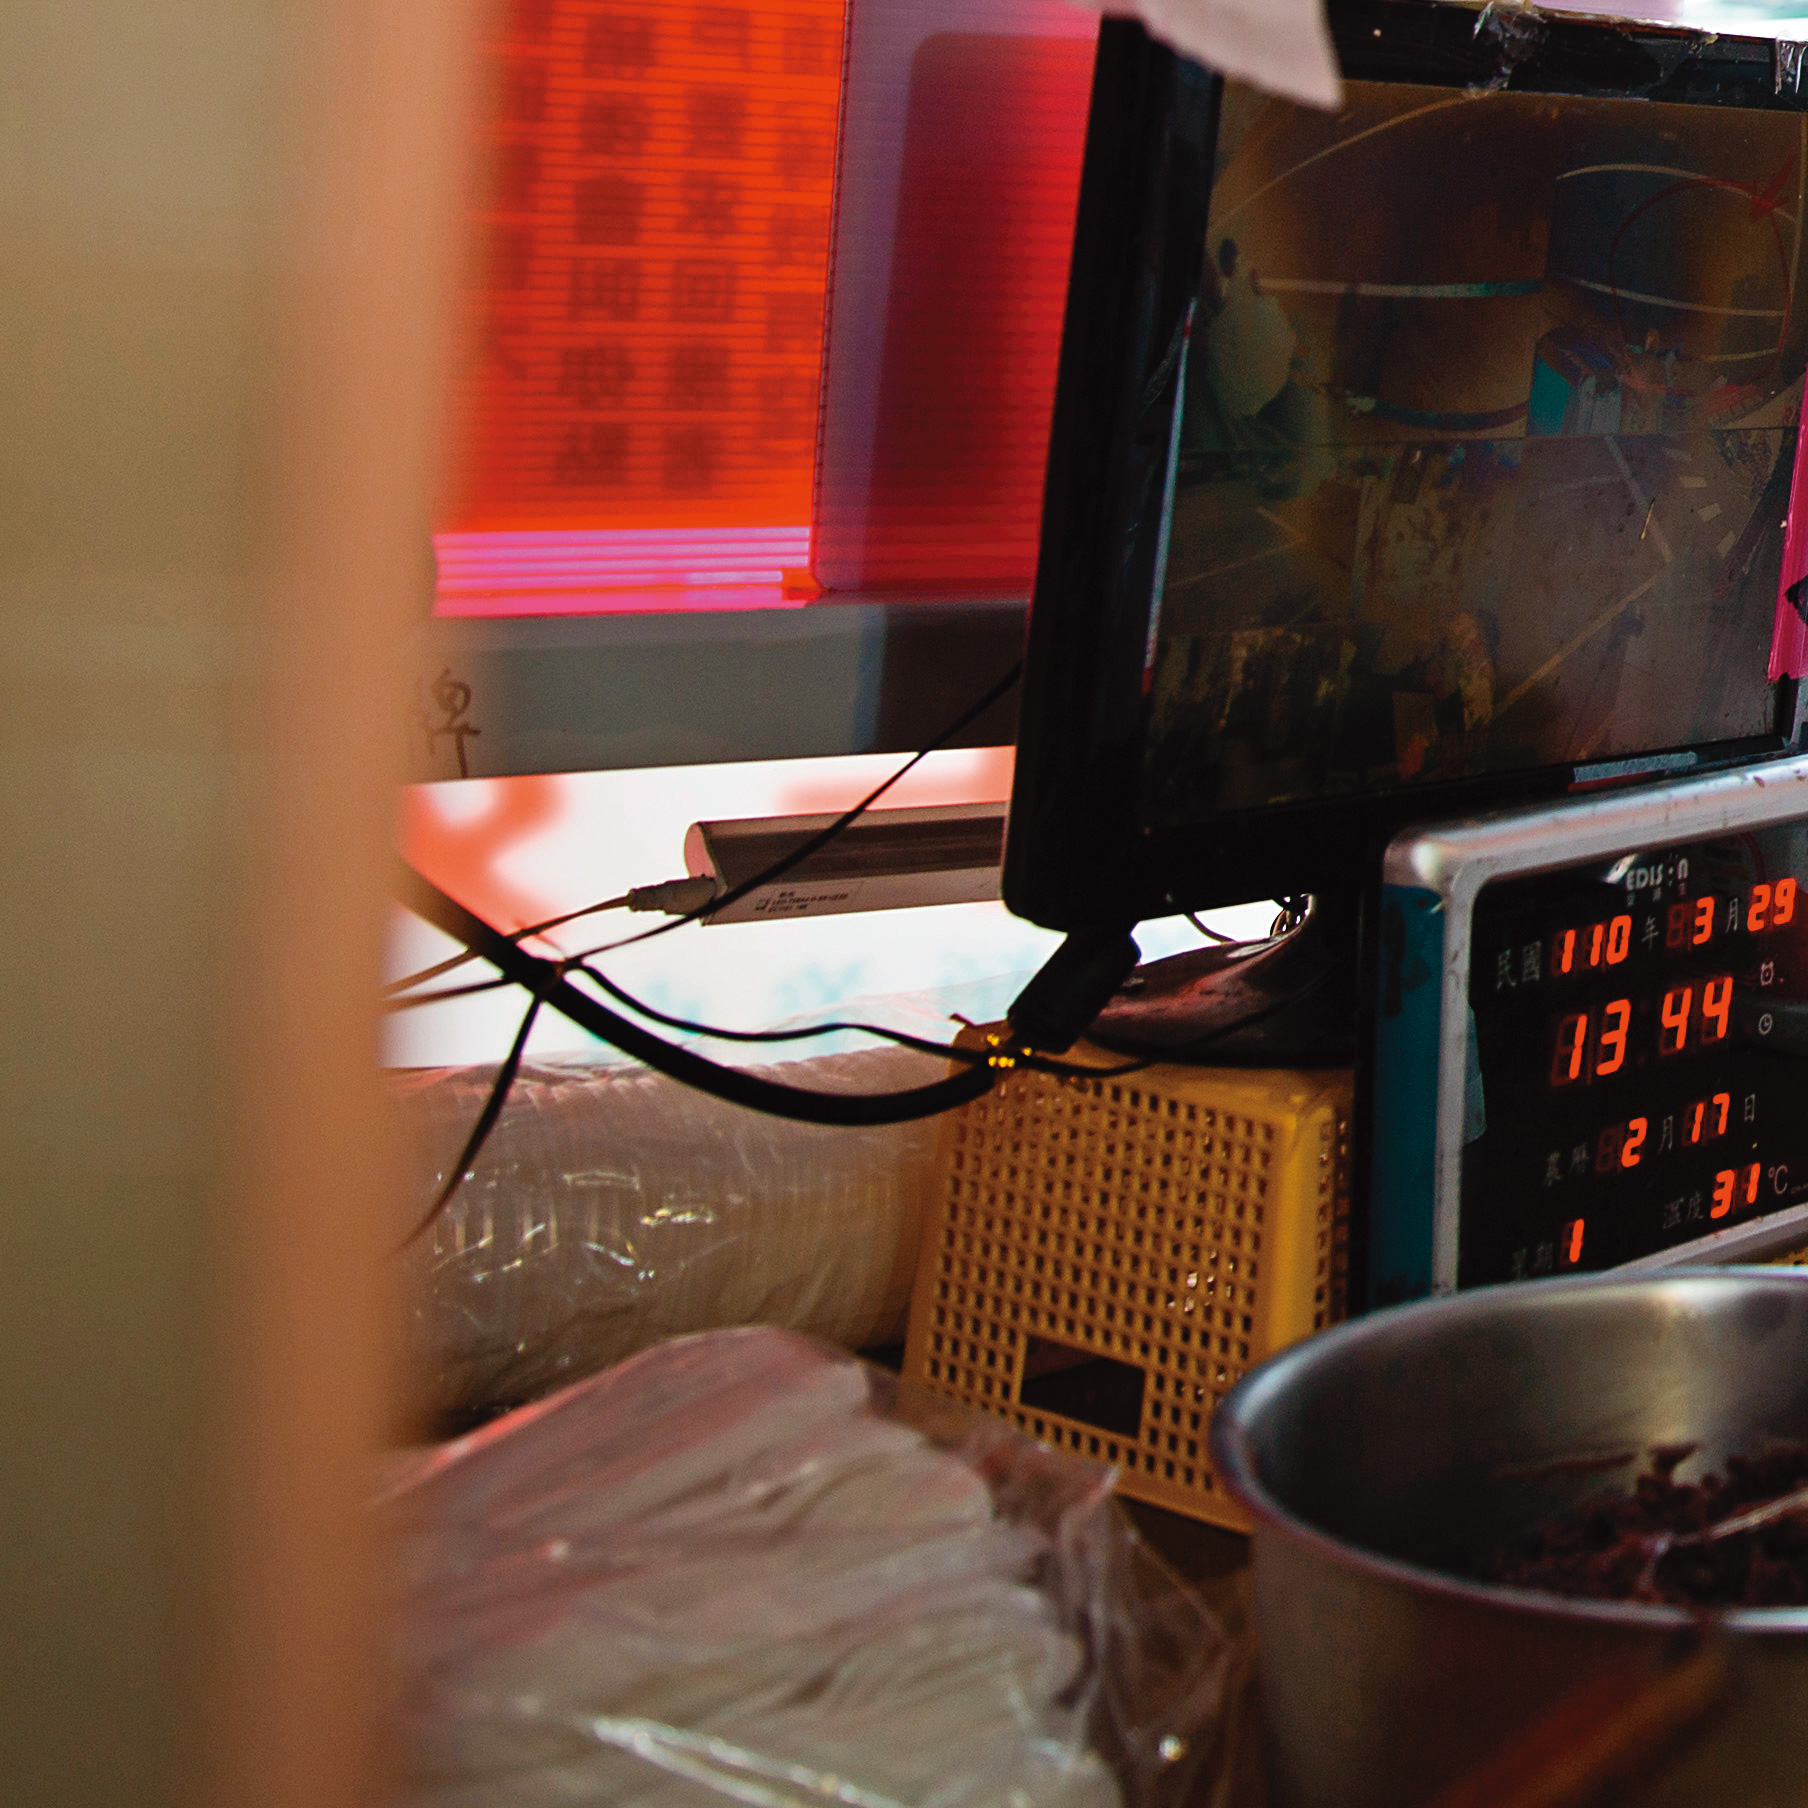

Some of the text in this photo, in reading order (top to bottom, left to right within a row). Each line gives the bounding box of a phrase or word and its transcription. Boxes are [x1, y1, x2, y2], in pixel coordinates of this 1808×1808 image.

[1560, 914, 1633, 974] 110
[1692, 895, 1715, 945] 3
[1726, 897, 1740, 935] 月
[1746, 877, 1797, 933] 29
[1621, 1117, 1648, 1168] 2
[1691, 1092, 1731, 1143] 17
[1710, 1161, 1761, 1220] 31
[1568, 1217, 1585, 1264] 1
